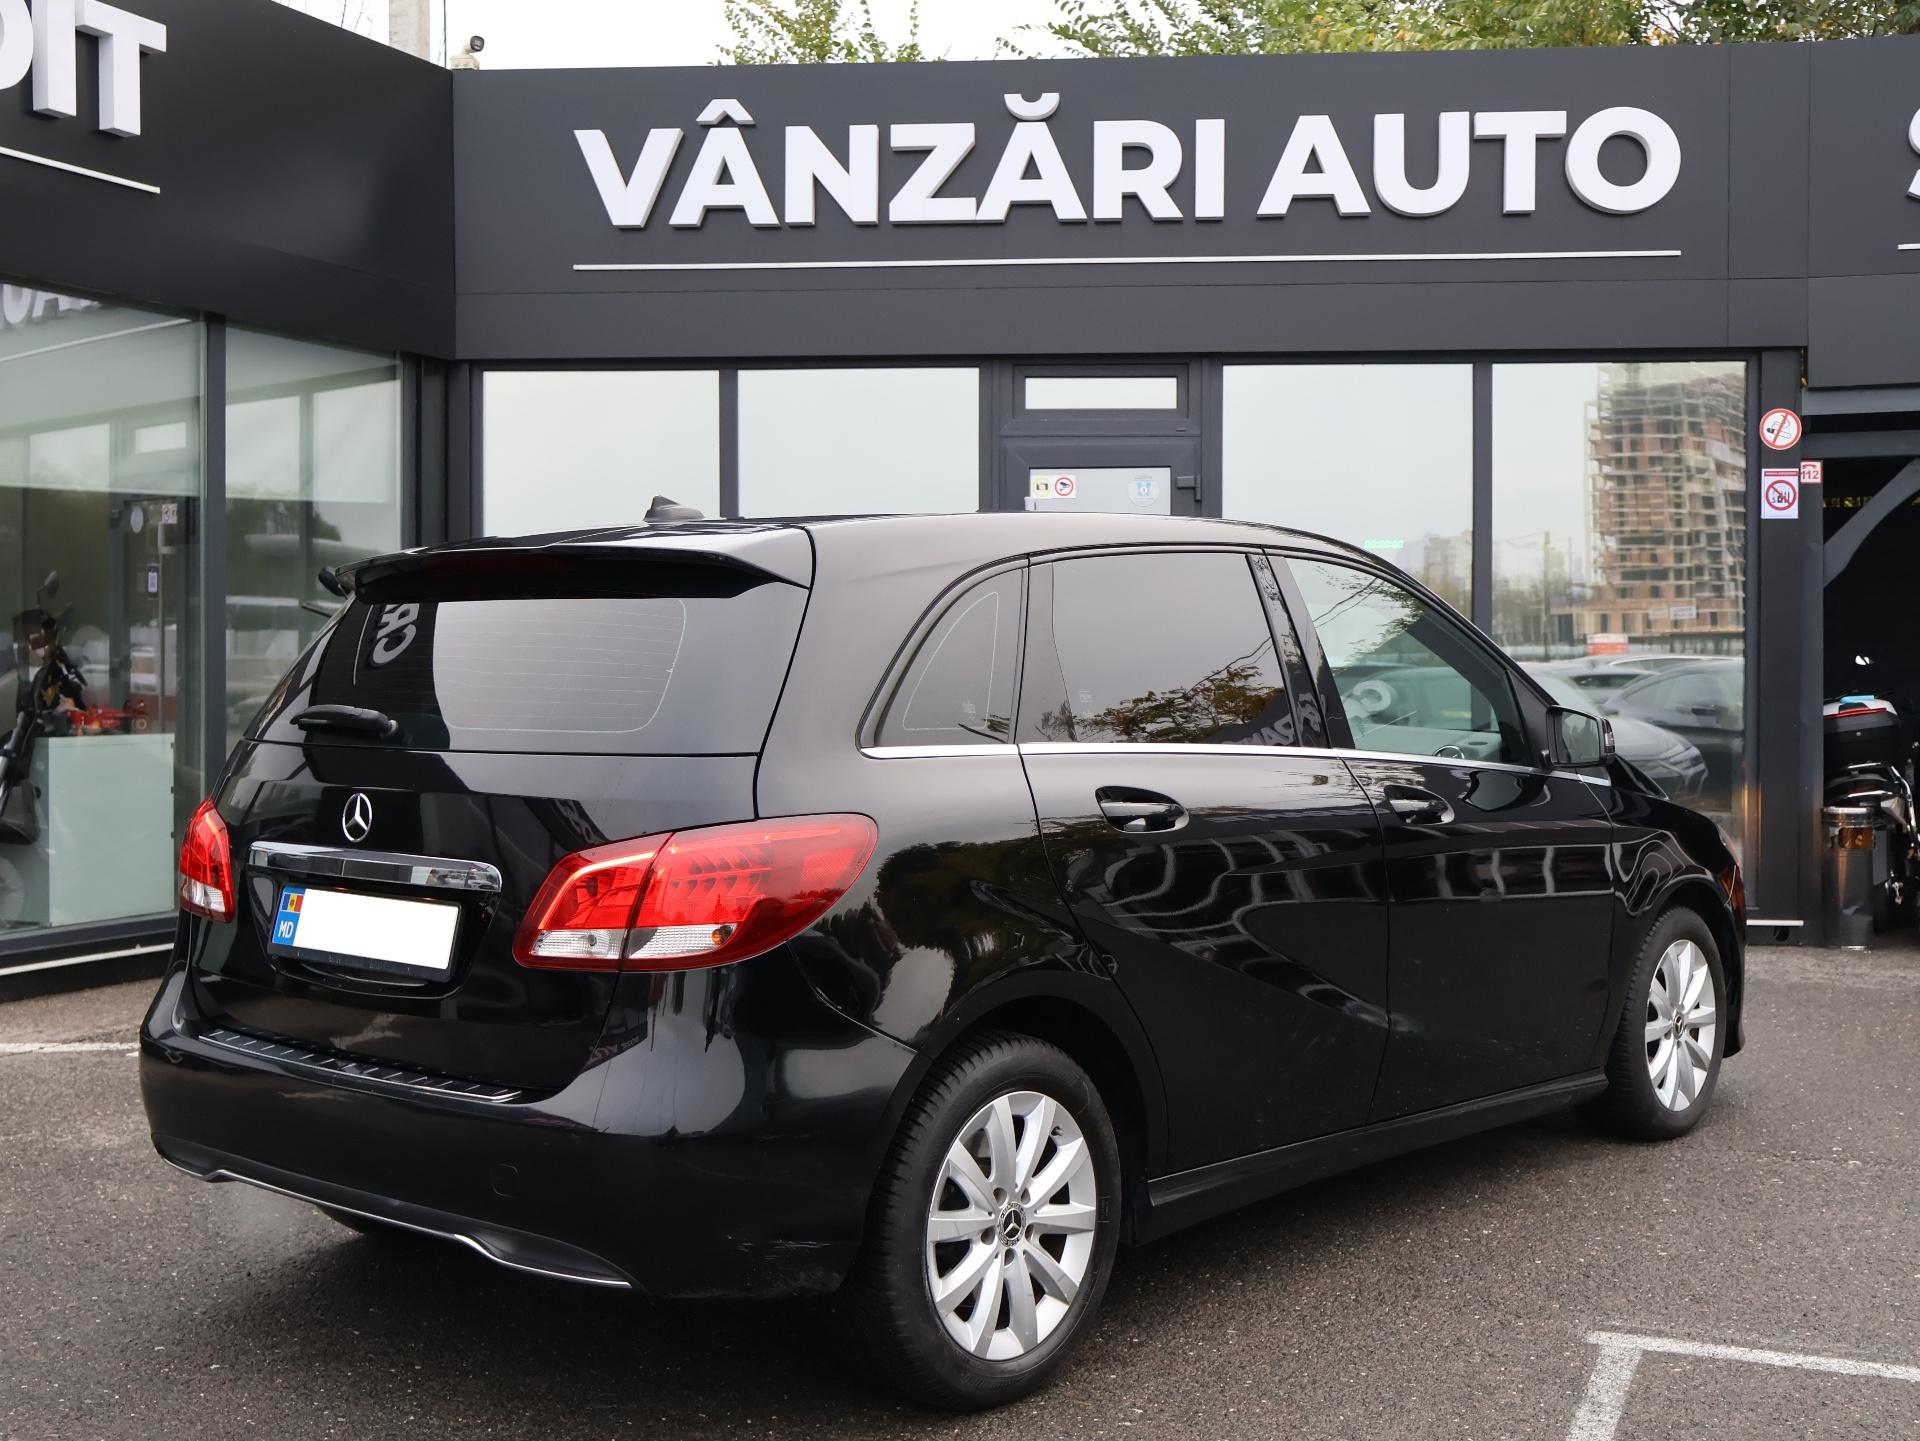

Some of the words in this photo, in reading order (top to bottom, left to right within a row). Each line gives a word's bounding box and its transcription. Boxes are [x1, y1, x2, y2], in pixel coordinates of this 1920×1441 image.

[573, 92, 1225, 229] VÂNZĂRI
[1256, 106, 1682, 218] AUTO
[1800, 470, 1820, 480] 112
[278, 920, 294, 939] MD
